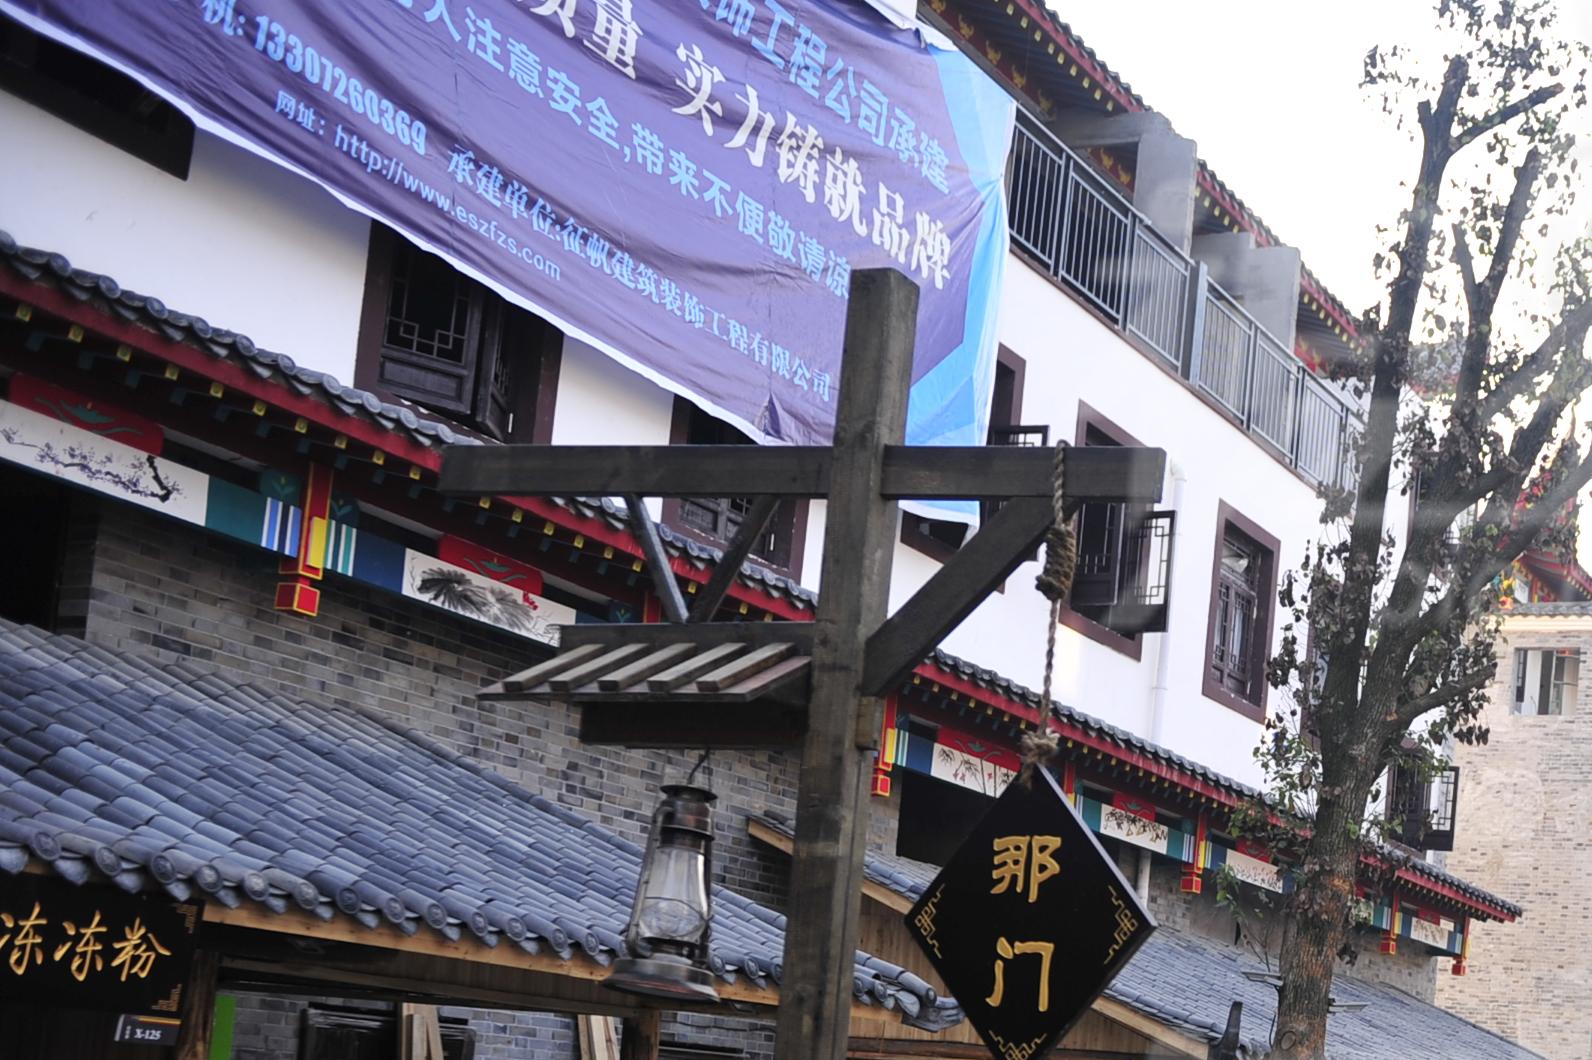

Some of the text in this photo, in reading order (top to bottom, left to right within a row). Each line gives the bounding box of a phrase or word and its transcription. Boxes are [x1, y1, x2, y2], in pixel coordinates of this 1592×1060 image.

[672, 42, 951, 290] 实力铸就品牌
[700, 0, 950, 193] 饰工程公司承建
[0, 901, 172, 982] 冻冻粉
[985, 835, 1062, 1012] 那门
[134, 1028, 162, 1040] X-125
